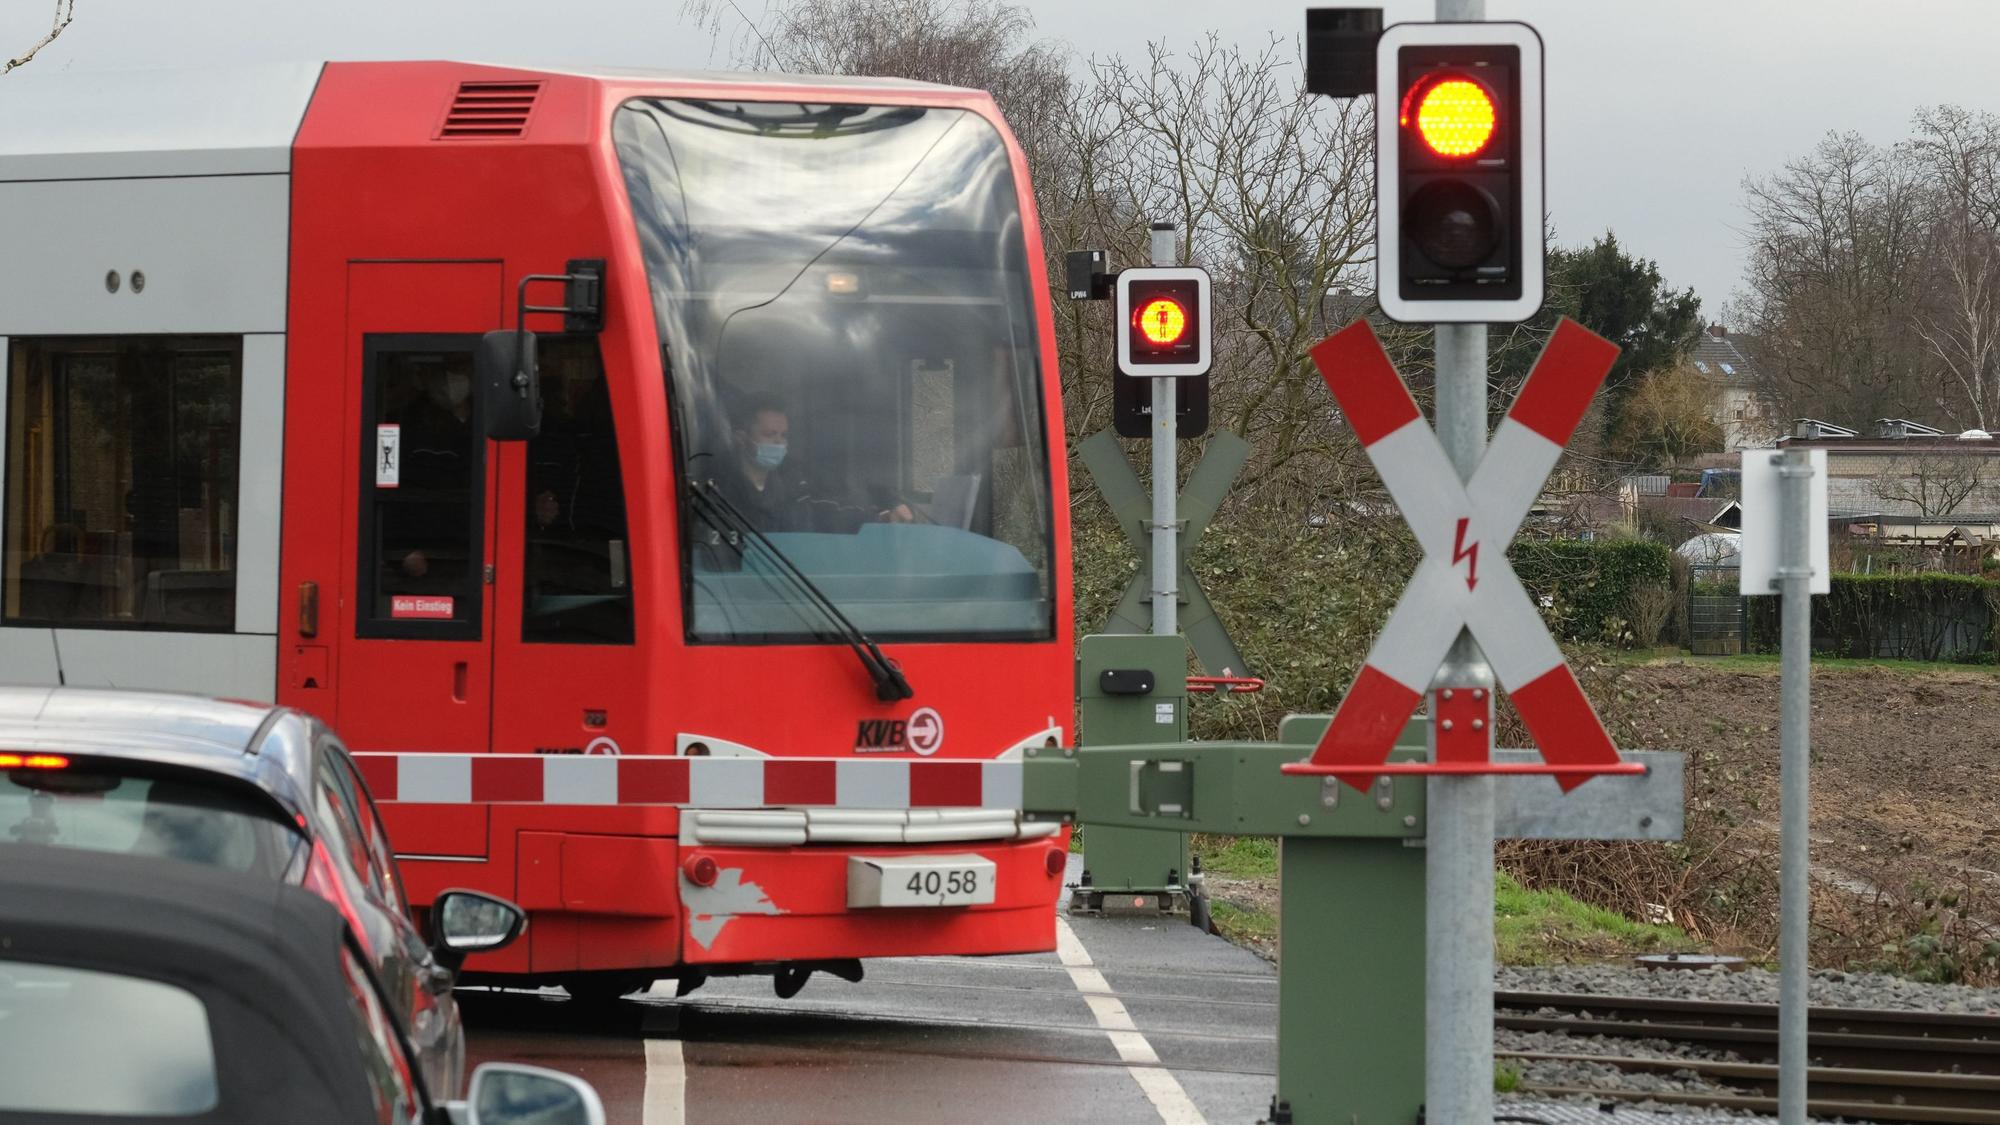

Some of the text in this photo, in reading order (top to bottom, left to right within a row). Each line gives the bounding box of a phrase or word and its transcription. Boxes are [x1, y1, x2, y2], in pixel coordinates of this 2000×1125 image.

[394, 600, 453, 614] Kein Einstieg
[856, 719, 907, 748] KVB
